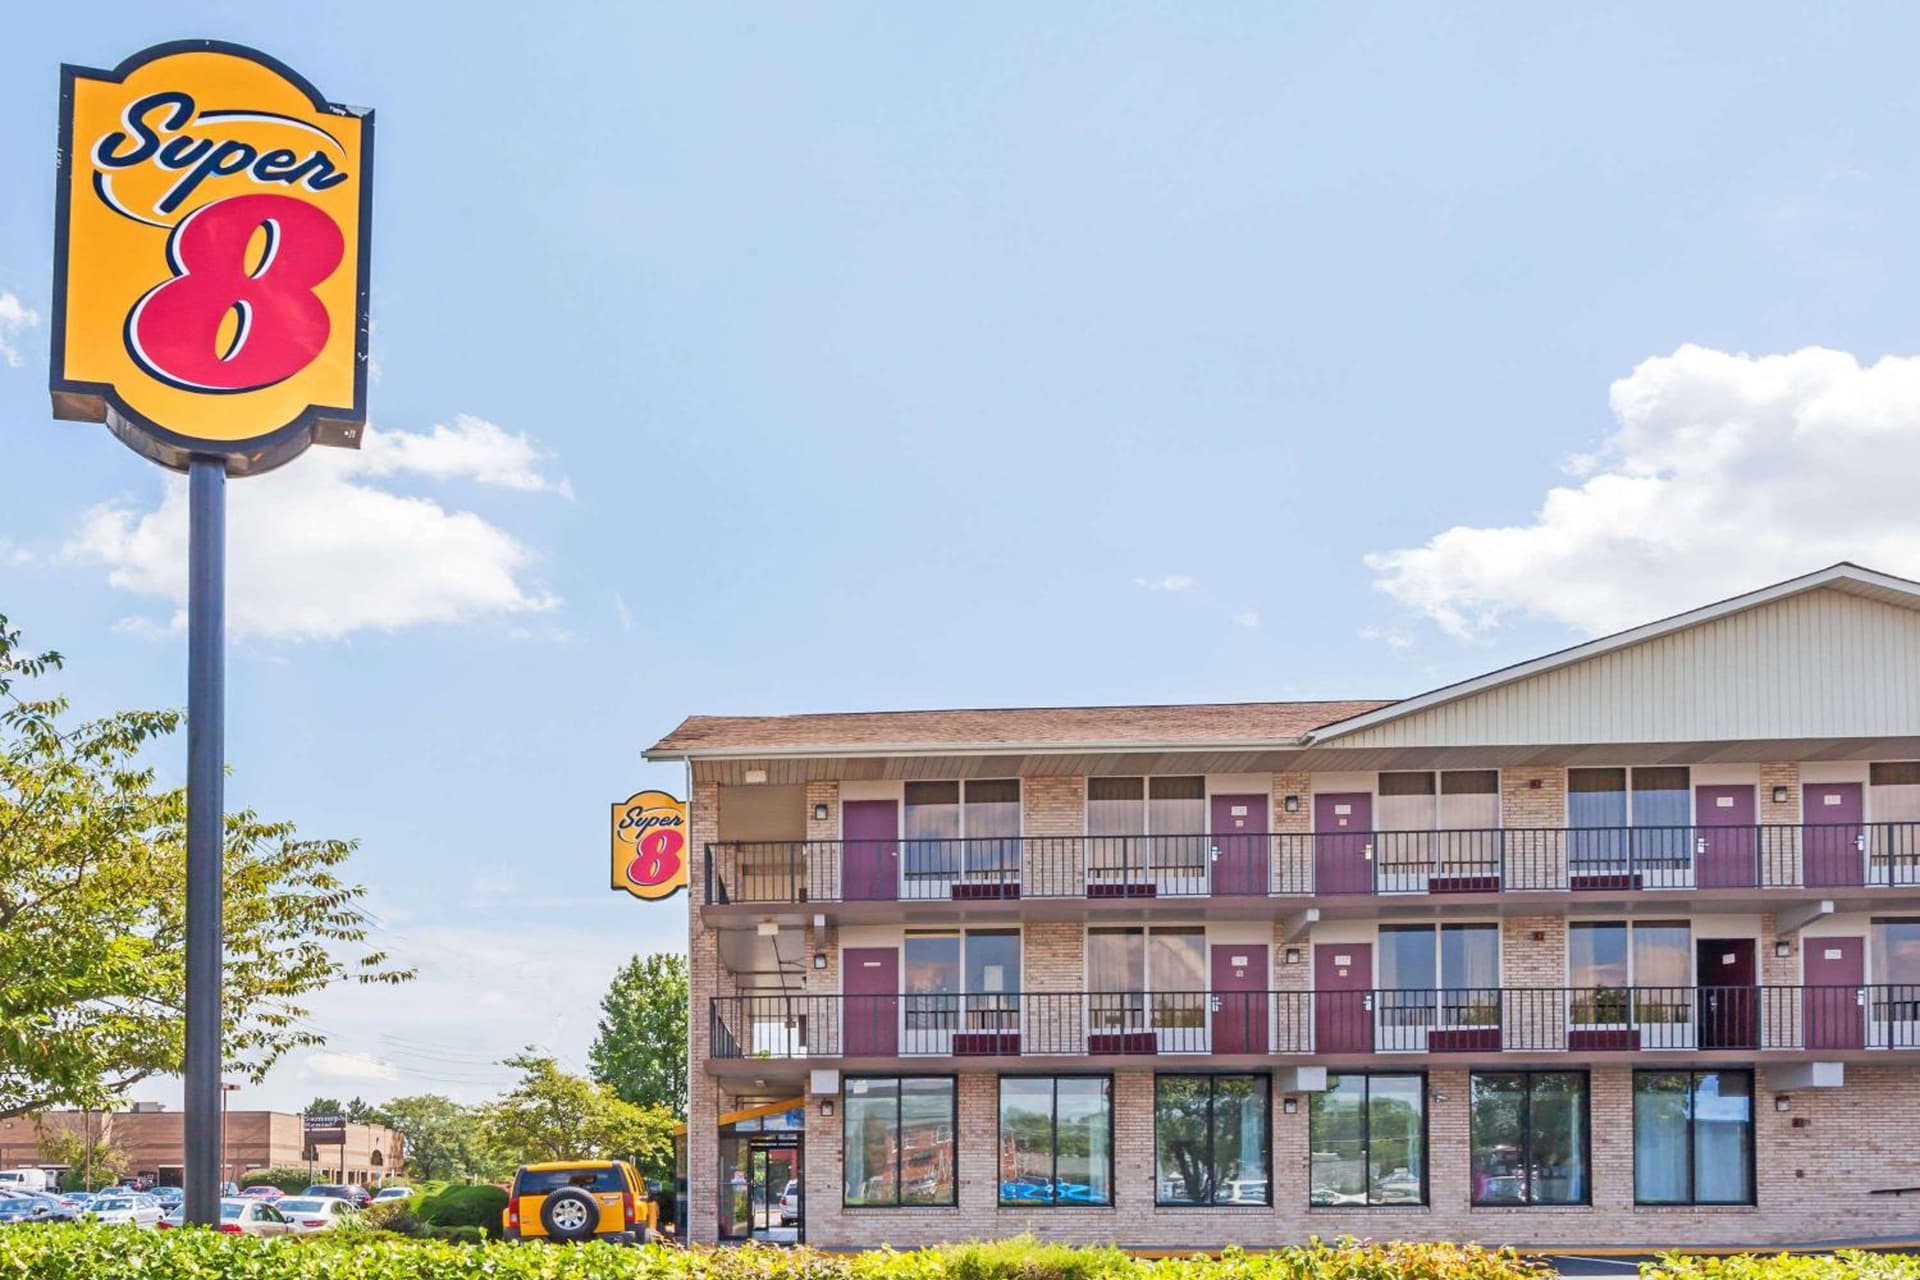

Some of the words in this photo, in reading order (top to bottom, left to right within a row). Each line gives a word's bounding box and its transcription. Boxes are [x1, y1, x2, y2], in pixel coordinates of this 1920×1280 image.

[92, 91, 349, 214] Super
[123, 193, 345, 394] 8
[619, 806, 684, 839] Super
[626, 829, 684, 886] 8
